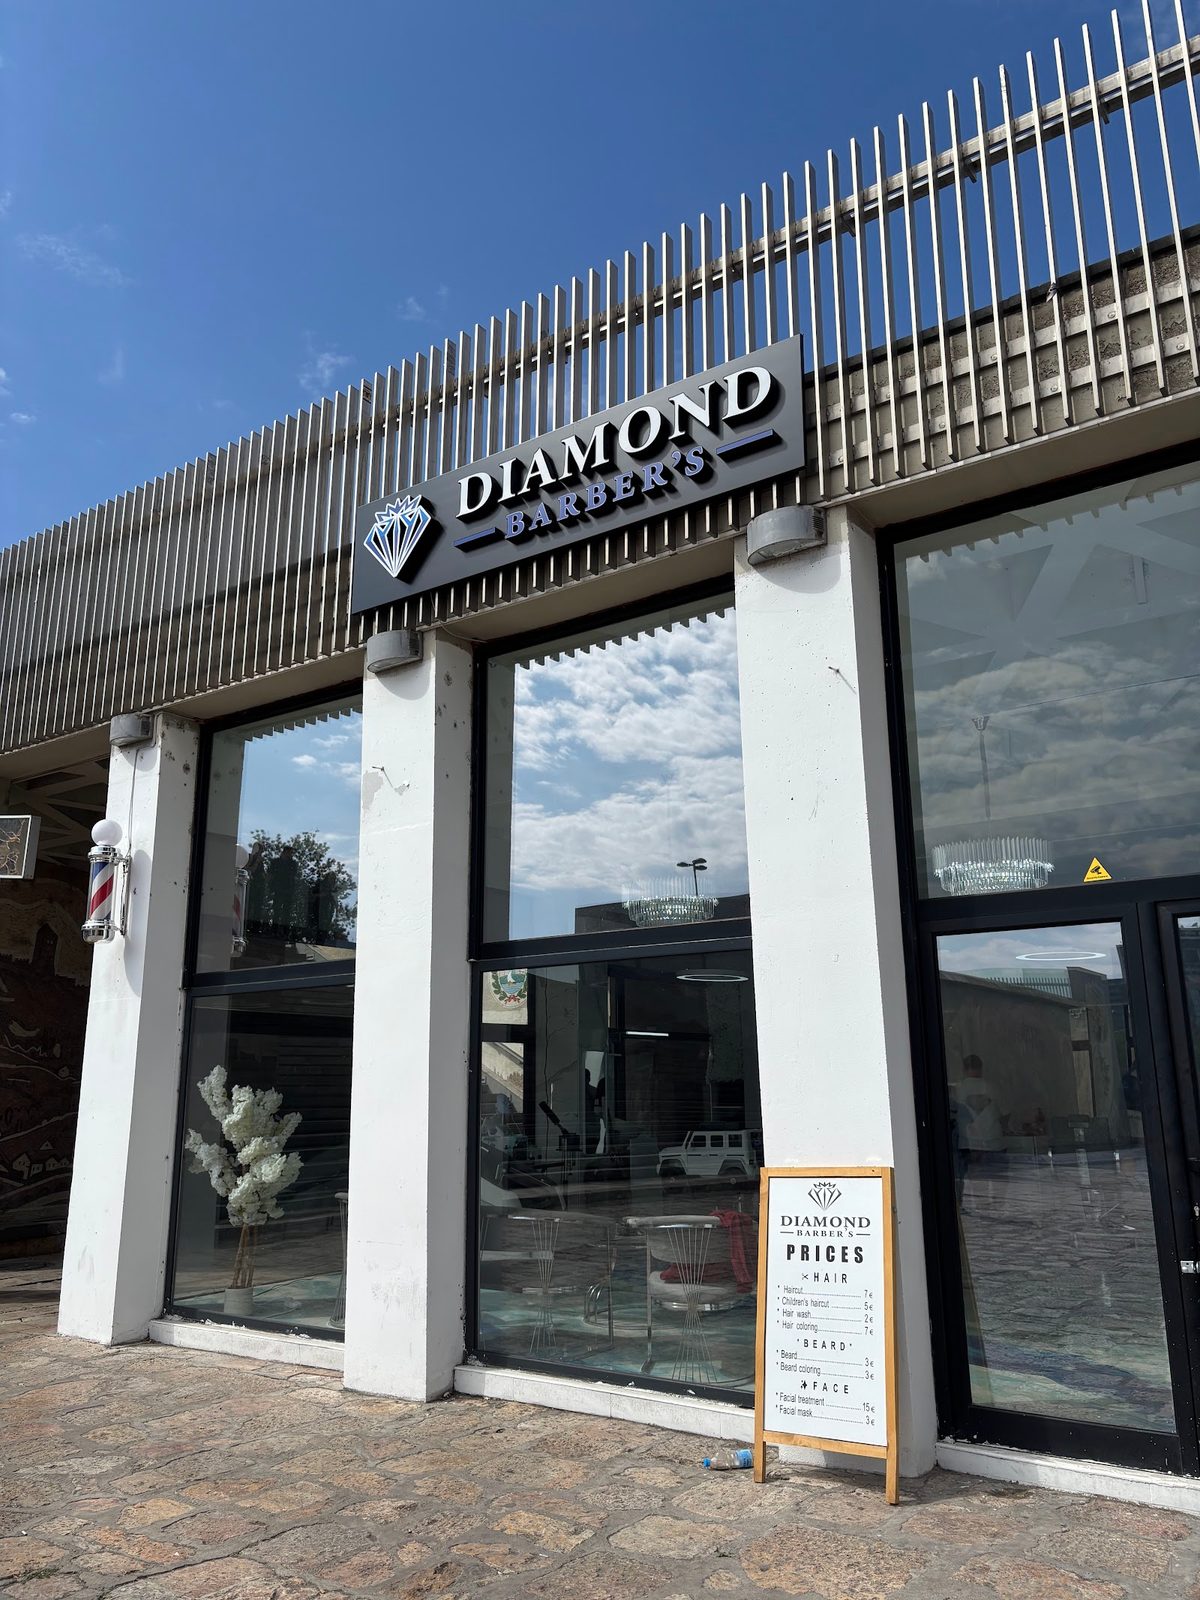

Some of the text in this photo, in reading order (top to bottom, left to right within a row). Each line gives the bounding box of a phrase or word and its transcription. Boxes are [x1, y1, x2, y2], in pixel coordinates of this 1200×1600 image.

[455, 365, 772, 519] DIAMOND
[504, 446, 704, 540] BARBER'S
[780, 1216, 871, 1228] DIAMOND
[797, 1227, 854, 1238] BARBER'S
[787, 1244, 864, 1264] PRICES
[814, 1272, 848, 1284] HAIR
[783, 1285, 803, 1294] Haircut
[782, 1296, 808, 1307] Children's
[810, 1298, 829, 1308] haircut
[782, 1308, 793, 1317] Hair
[796, 1309, 811, 1318] wash
[782, 1320, 793, 1329] Hair
[796, 1321, 818, 1333] coloring
[803, 1338, 846, 1351] BEARD
[780, 1350, 798, 1360] Beard
[780, 1361, 797, 1372] Beard
[798, 1364, 821, 1377] coloring
[813, 1381, 849, 1394] FACE
[779, 1392, 796, 1403] Facial
[797, 1394, 825, 1406] treatment
[779, 1404, 796, 1415] Facial
[797, 1407, 813, 1417] mask
